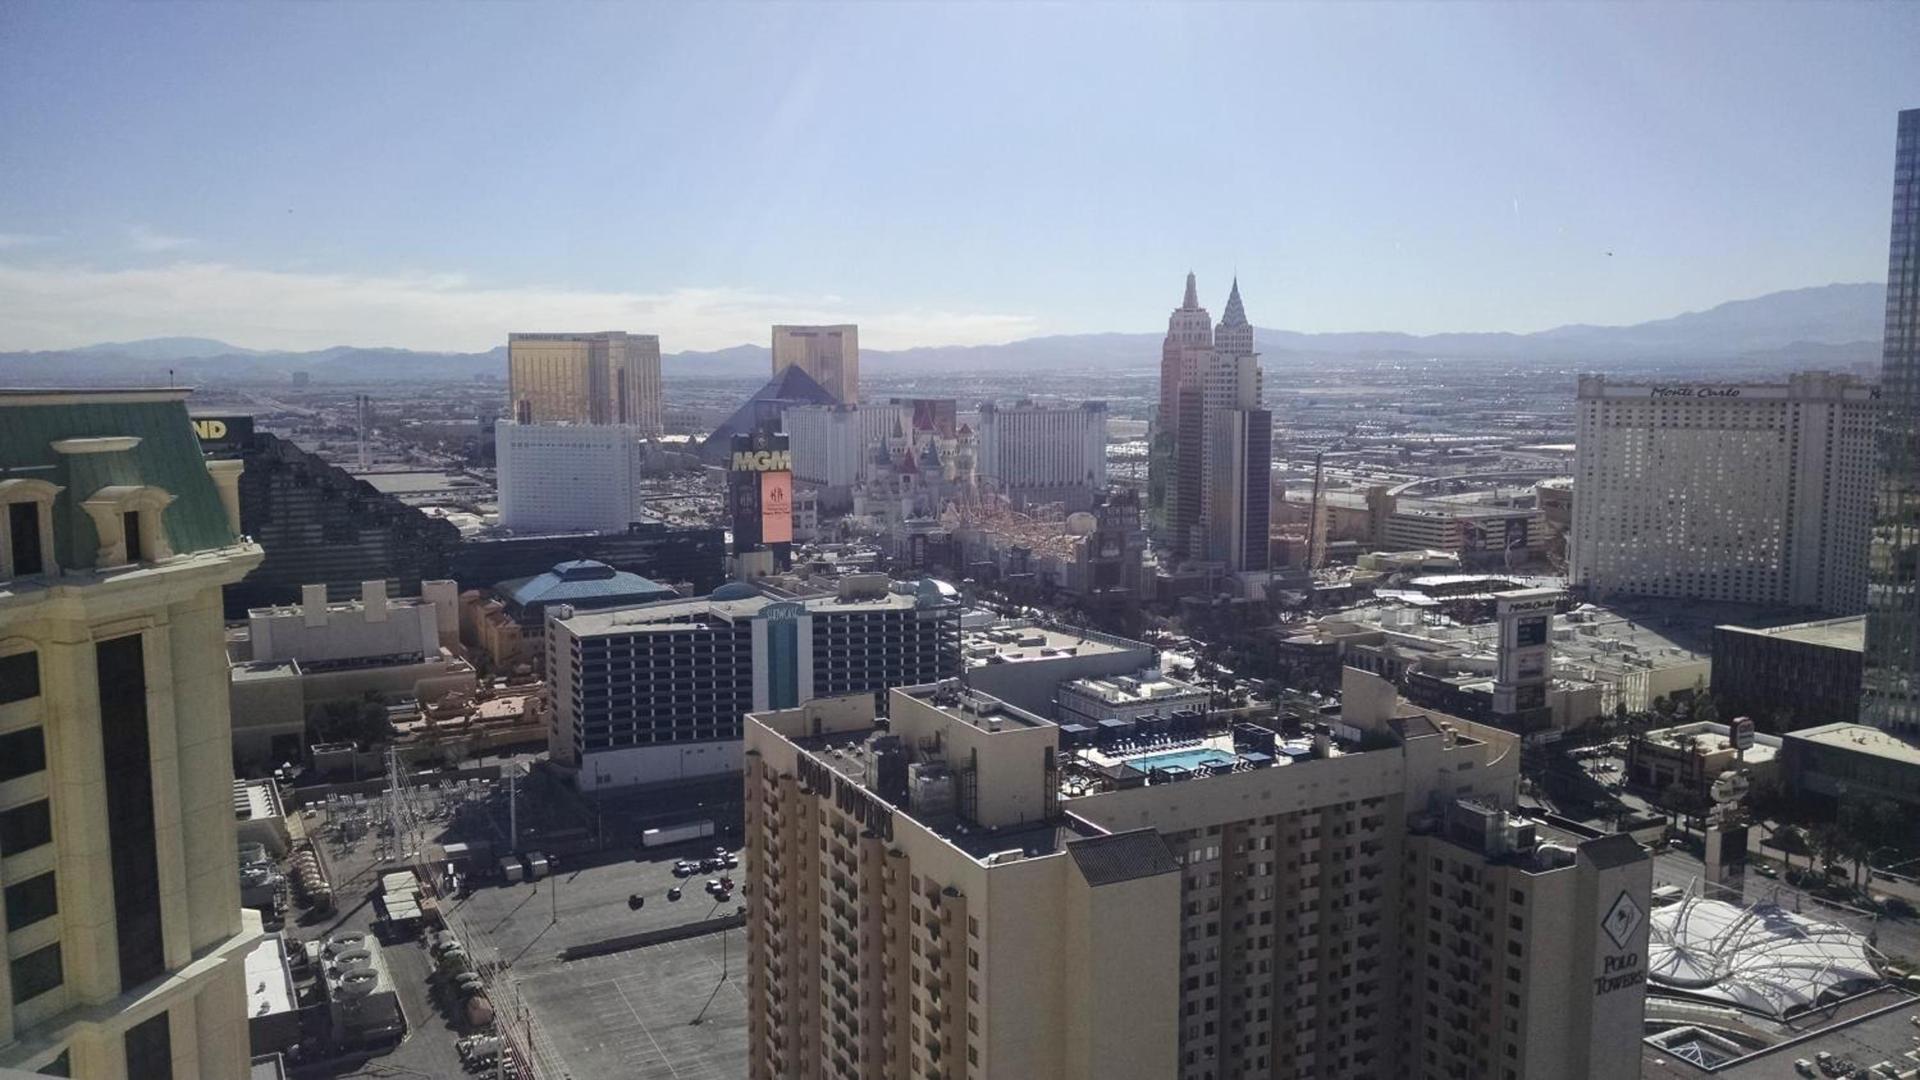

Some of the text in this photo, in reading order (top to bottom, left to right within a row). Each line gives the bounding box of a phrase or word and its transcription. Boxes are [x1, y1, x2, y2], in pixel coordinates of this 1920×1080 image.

[1651, 386, 1740, 398] Monte Carlo
[732, 450, 791, 471] MGM
[1603, 953, 1638, 974] POLO
[1594, 970, 1644, 995] TOWERS
